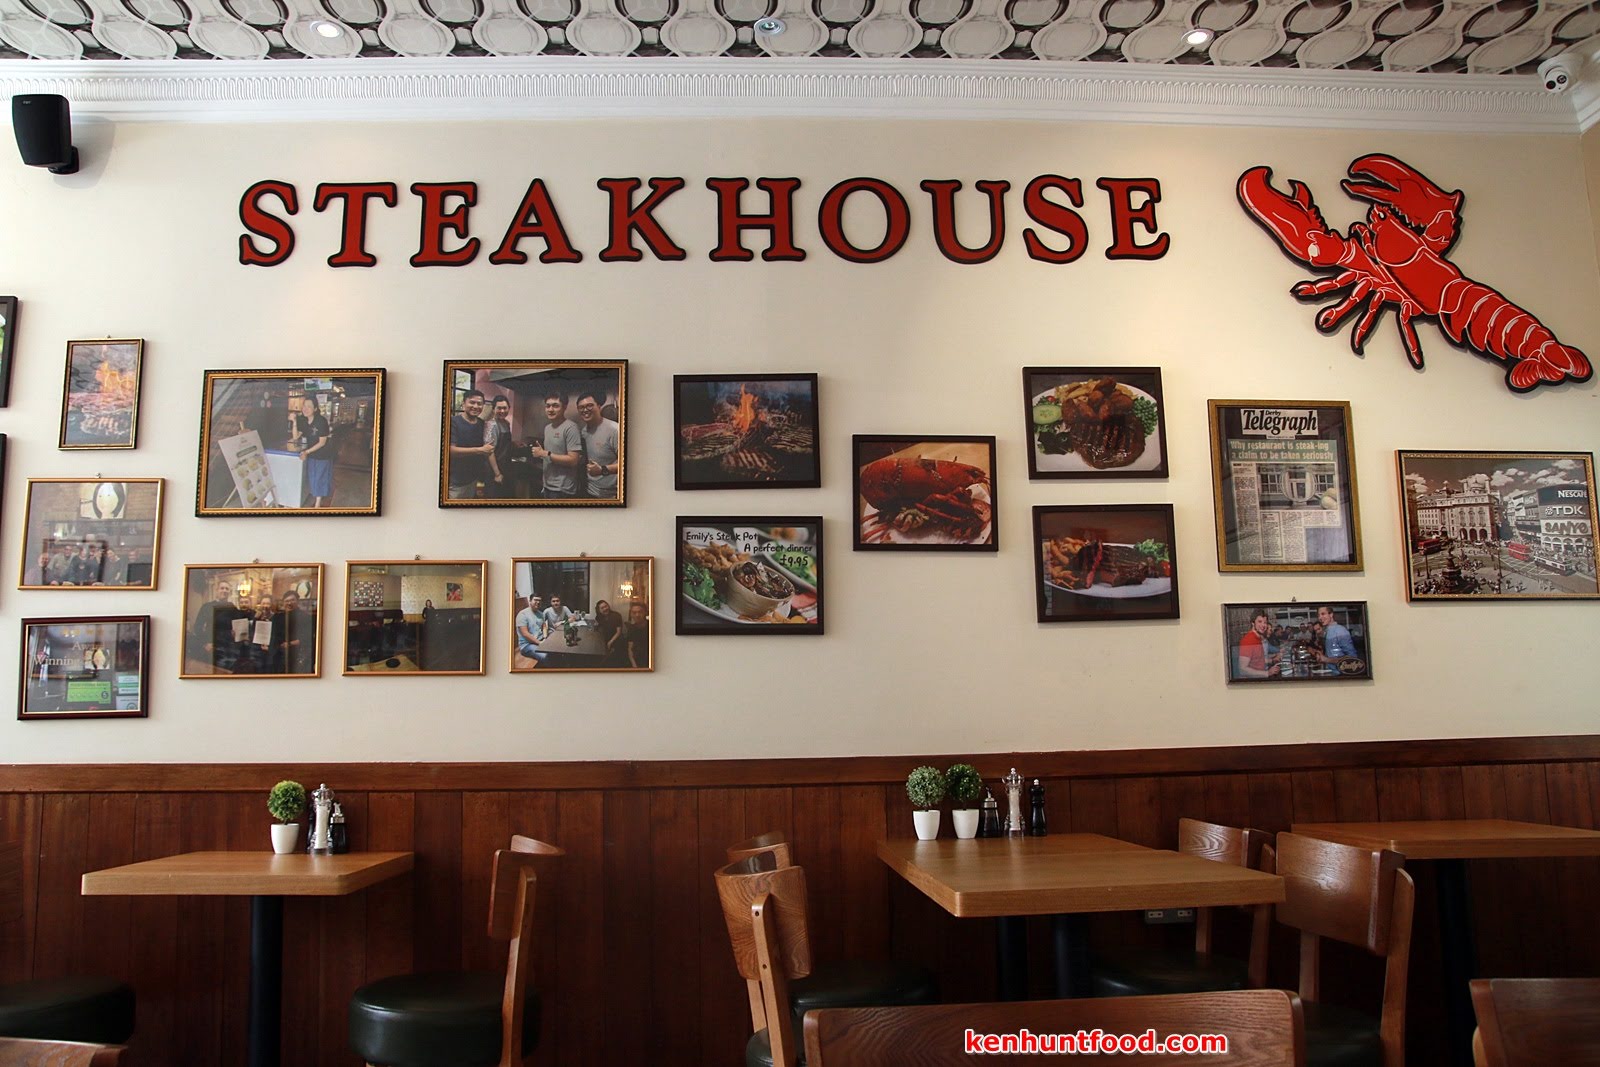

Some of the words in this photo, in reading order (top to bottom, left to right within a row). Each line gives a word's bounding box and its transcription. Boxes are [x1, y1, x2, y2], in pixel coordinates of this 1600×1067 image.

[239, 174, 1171, 267] STEAKHOUSE
[1243, 410, 1317, 435] Telegraph
[1248, 441, 1285, 450] restaurant
[1287, 442, 1294, 450] is
[1296, 442, 1329, 451] steak-ing
[1239, 451, 1258, 459] claim
[1269, 451, 1279, 459] be
[1281, 451, 1301, 460] taken
[1303, 452, 1334, 460] seriously
[1545, 521, 1588, 535] SANYO
[686, 531, 714, 542] Emily's
[743, 531, 758, 541] Pot
[744, 543, 751, 552] A
[753, 543, 785, 554] perfect
[787, 543, 813, 553] dinner
[780, 554, 809, 567] £9.95
